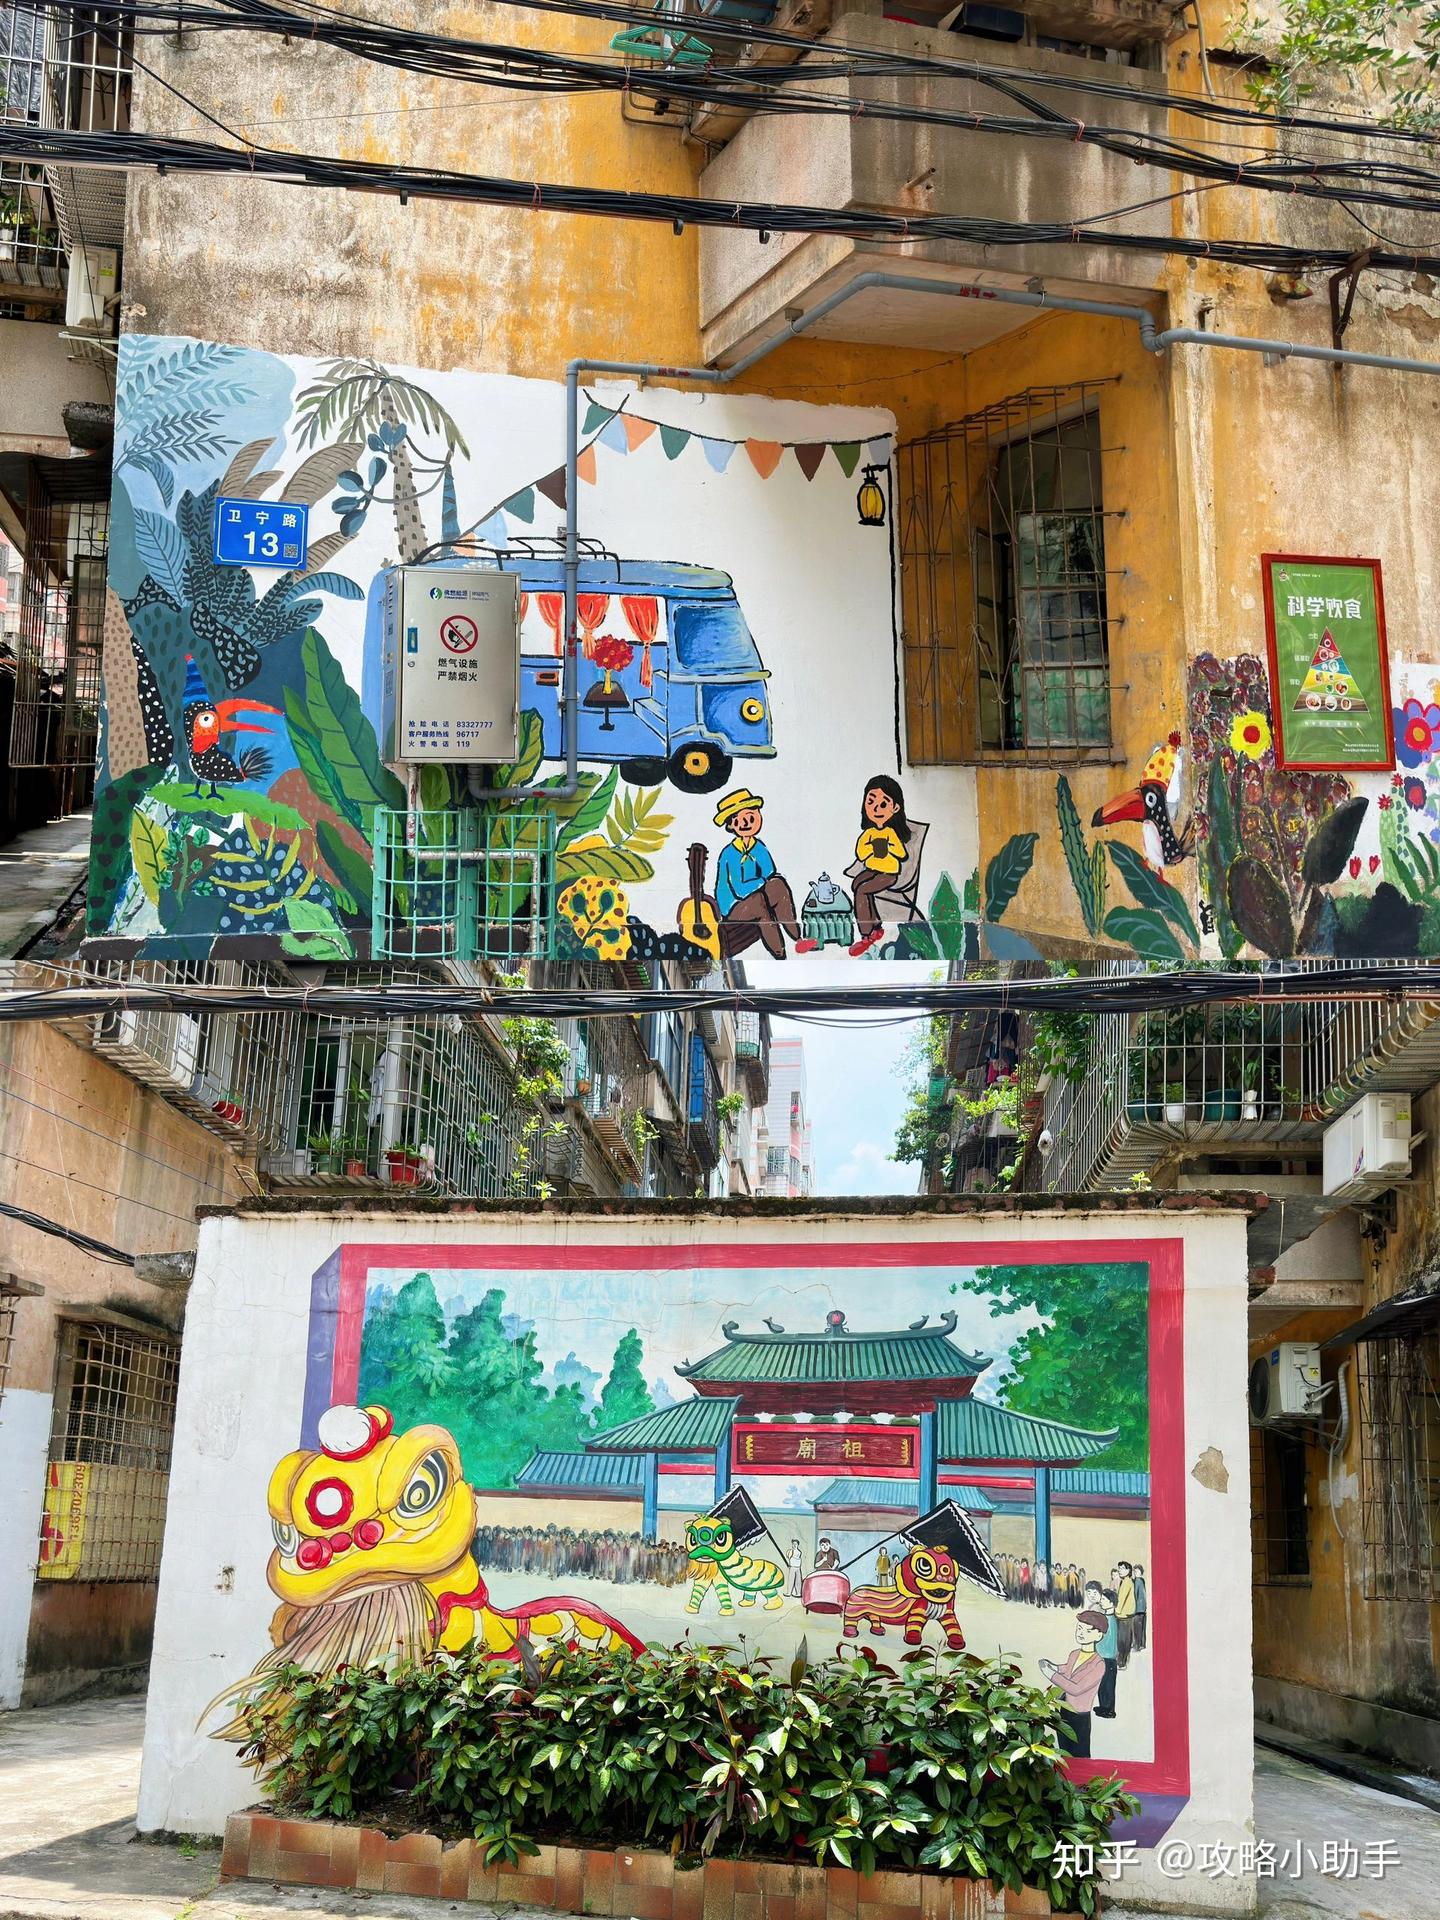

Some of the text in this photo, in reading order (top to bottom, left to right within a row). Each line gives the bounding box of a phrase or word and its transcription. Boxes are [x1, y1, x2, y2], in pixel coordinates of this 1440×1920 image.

[227, 509, 297, 528] 卫宁路
[243, 531, 279, 557] 13
[1287, 595, 1362, 620] 科学饮食
[438, 657, 478, 669] 燃气设施
[437, 670, 478, 682] 严禁烟火
[456, 720, 493, 729] 83327777
[408, 730, 479, 738] 客户服务热线 96717
[408, 740, 470, 748] 火警电话 119
